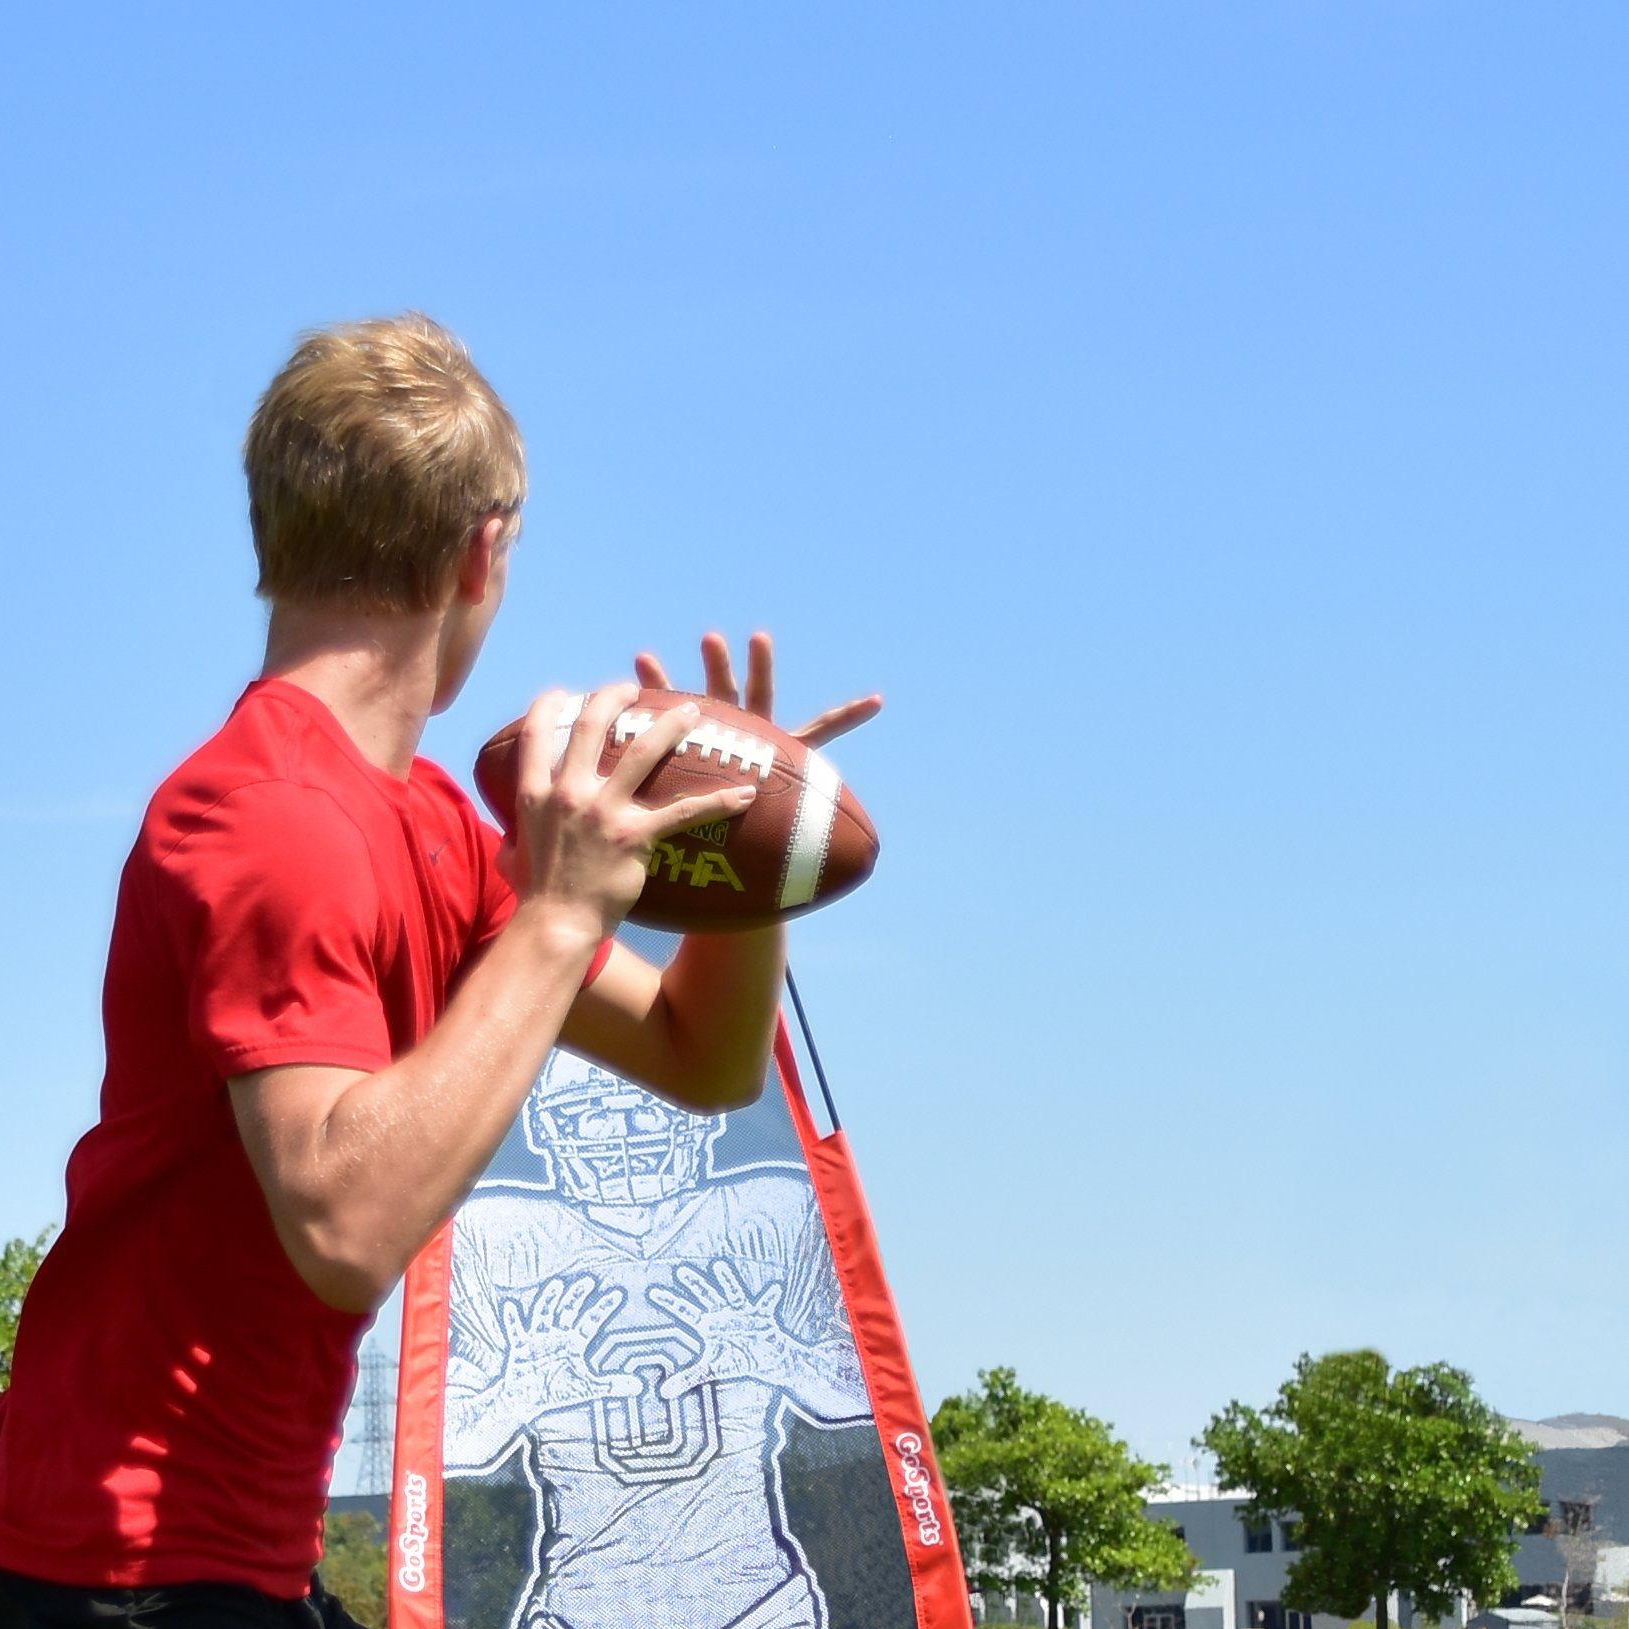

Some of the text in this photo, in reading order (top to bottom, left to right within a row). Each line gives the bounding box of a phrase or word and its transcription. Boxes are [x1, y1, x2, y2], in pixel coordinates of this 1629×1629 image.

[648, 841, 746, 892] PHA
[399, 1473, 428, 1592] GoSports
[896, 1432, 940, 1545] GoSports
